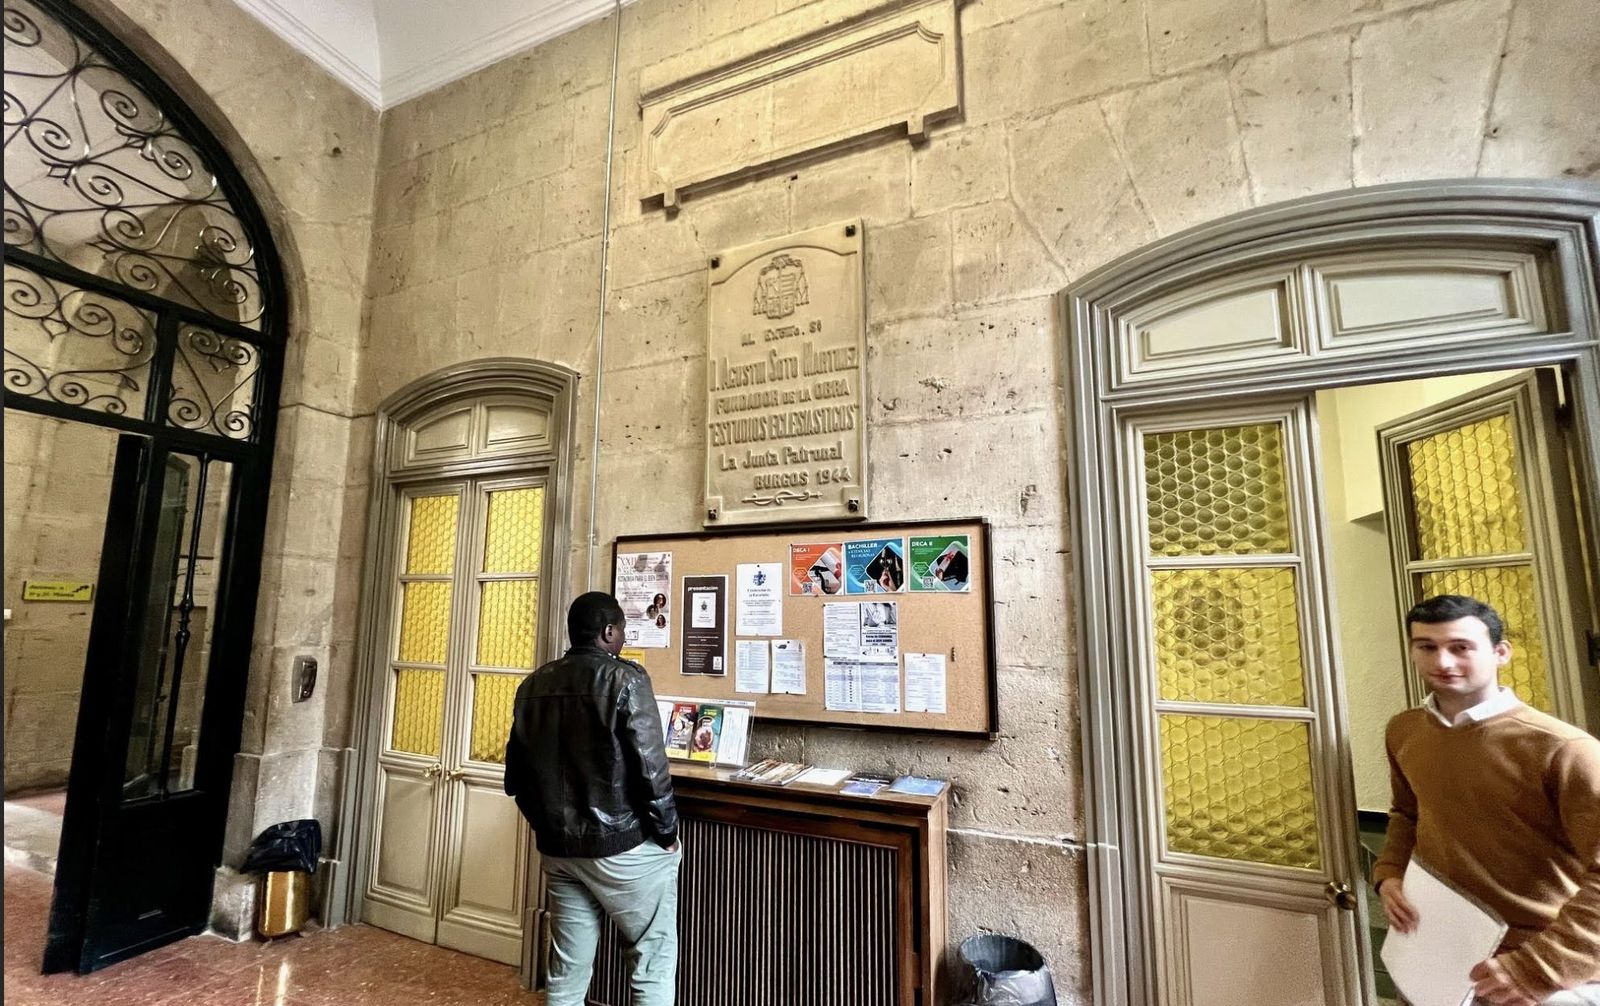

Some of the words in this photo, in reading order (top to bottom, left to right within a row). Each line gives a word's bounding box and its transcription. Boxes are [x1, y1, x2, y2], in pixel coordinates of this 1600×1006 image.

[716, 389, 779, 415] FUNDADOR
[782, 391, 795, 404] DE
[798, 389, 812, 403] LA
[814, 378, 850, 400] OBRA
[720, 452, 737, 471] La
[742, 449, 779, 469] Junta
[783, 440, 843, 465] Patronal
[754, 471, 809, 490] BURGOS
[816, 467, 852, 486] 1944
